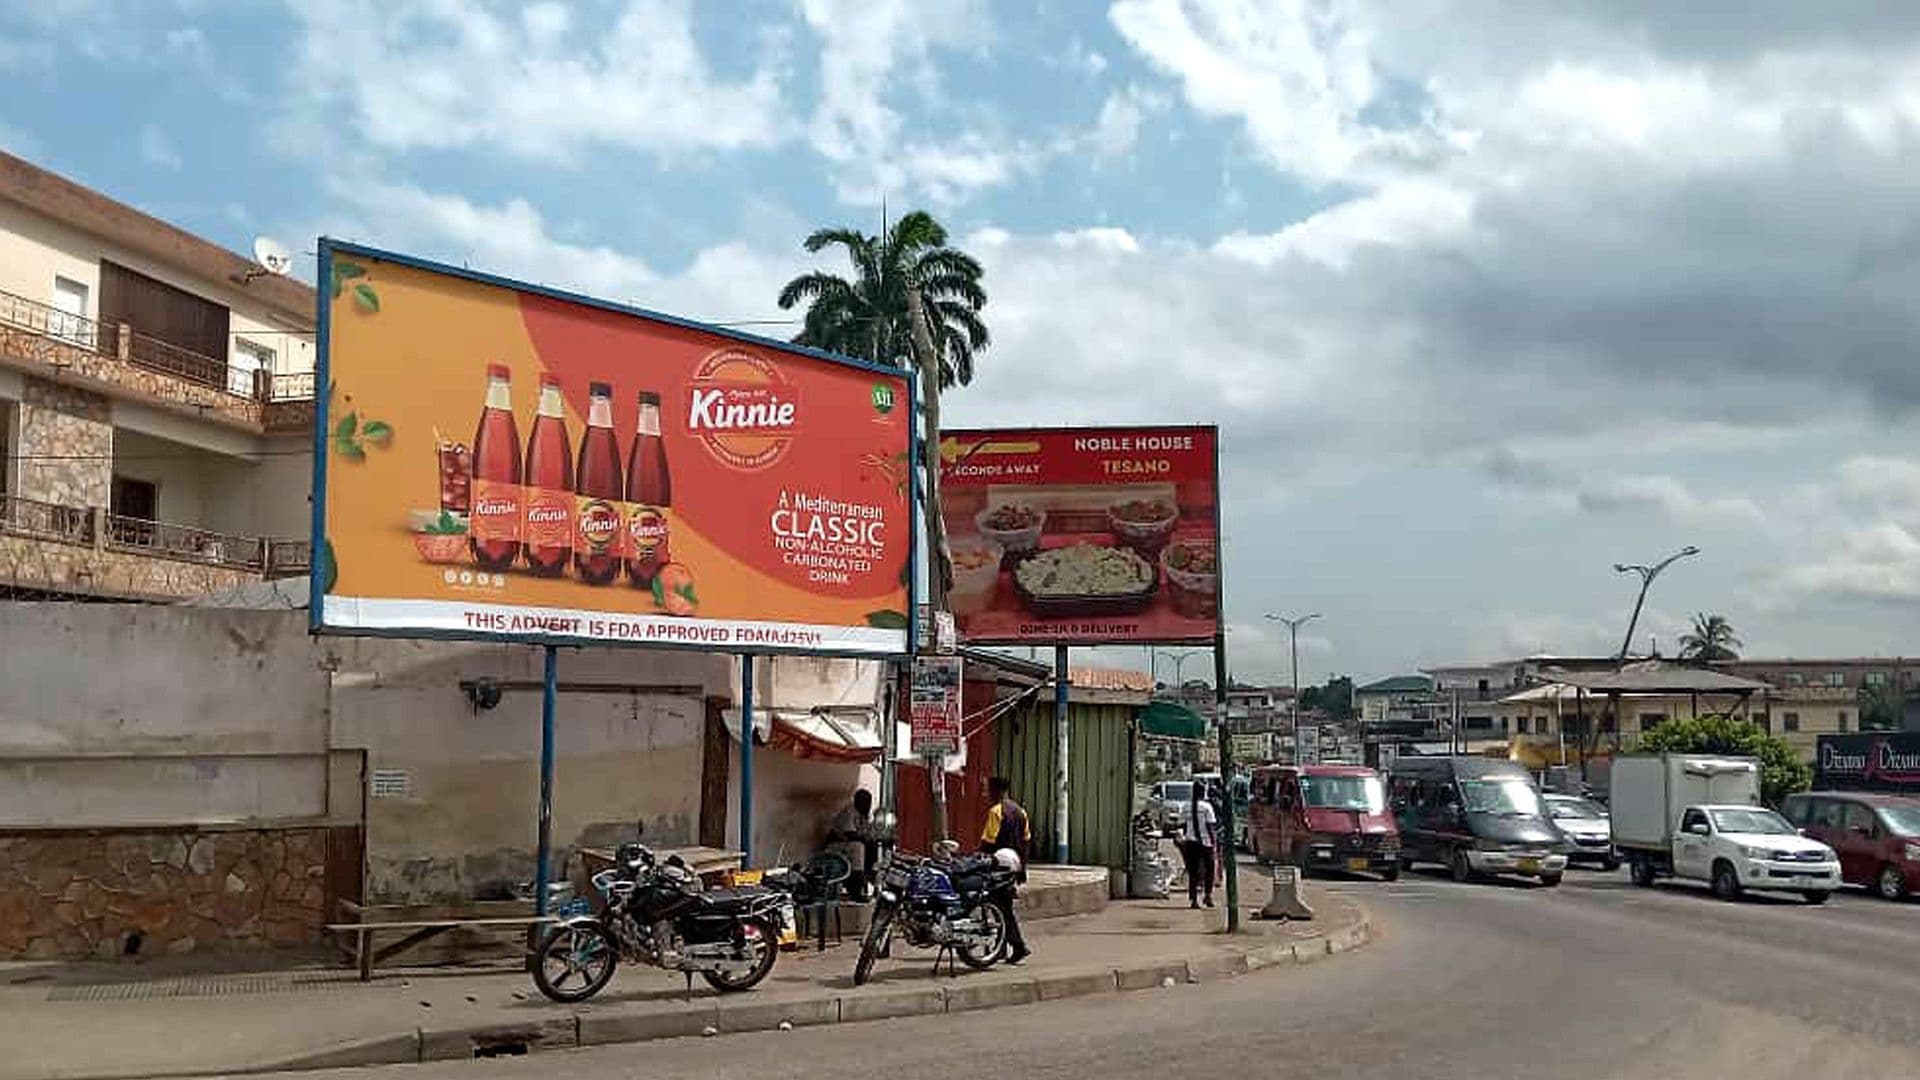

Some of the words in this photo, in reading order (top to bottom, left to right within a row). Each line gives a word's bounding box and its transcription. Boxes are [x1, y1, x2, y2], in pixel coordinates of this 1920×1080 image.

[689, 388, 796, 430] Kinnie
[1074, 437, 1131, 451] NOBLE
[1135, 436, 1193, 450] HOUSE
[1005, 463, 1041, 474] AWAY
[1102, 459, 1171, 473] TESANO
[779, 490, 789, 509] A
[794, 493, 884, 521] Mediterranean
[771, 508, 885, 548] CLASSIC
[775, 536, 884, 560] NON-ALCOHOLIC
[783, 552, 872, 572] CARBONATED
[809, 570, 850, 584] DRINK
[464, 612, 506, 630] THIS
[510, 615, 582, 633] ADVERT
[589, 619, 604, 635] IS
[608, 622, 642, 638] FDA
[646, 624, 730, 641] APPROVED
